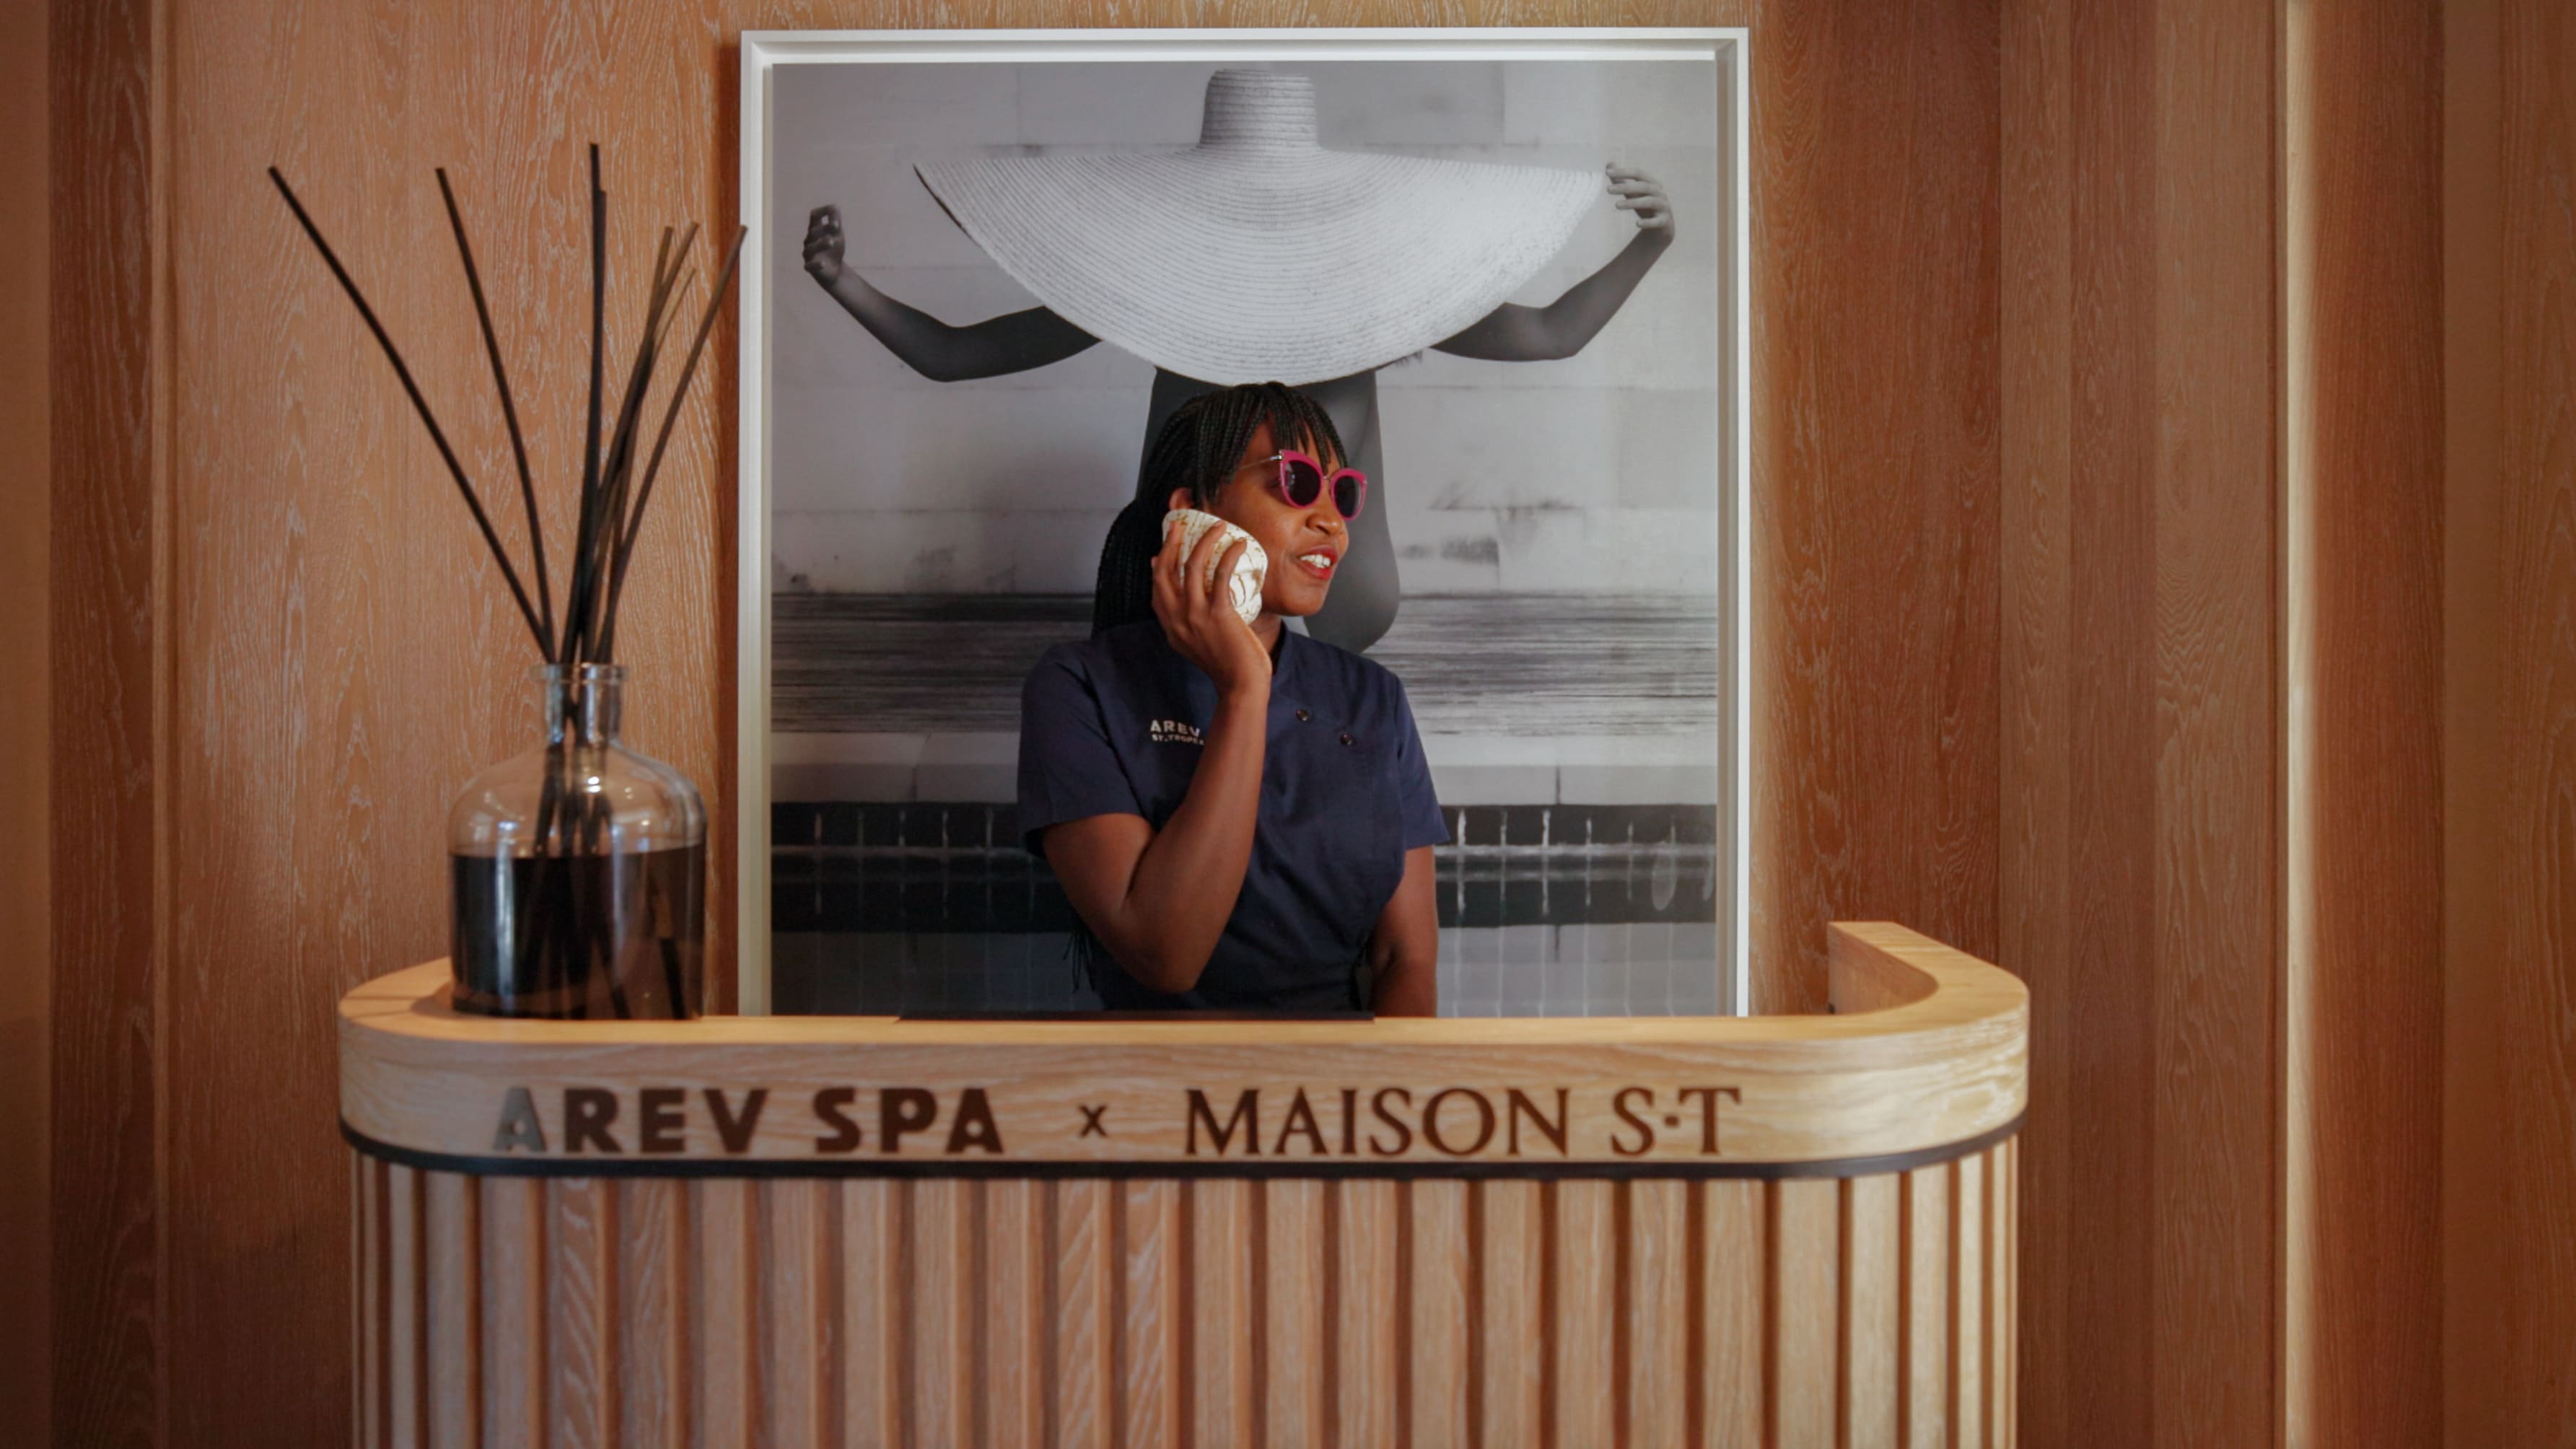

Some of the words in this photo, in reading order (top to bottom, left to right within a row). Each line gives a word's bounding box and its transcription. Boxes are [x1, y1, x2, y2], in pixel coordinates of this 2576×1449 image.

[1150, 719, 1200, 737] AREV
[492, 1087, 768, 1153] AREV
[812, 1087, 1004, 1153] SPA
[1184, 1087, 1572, 1156] MAISON
